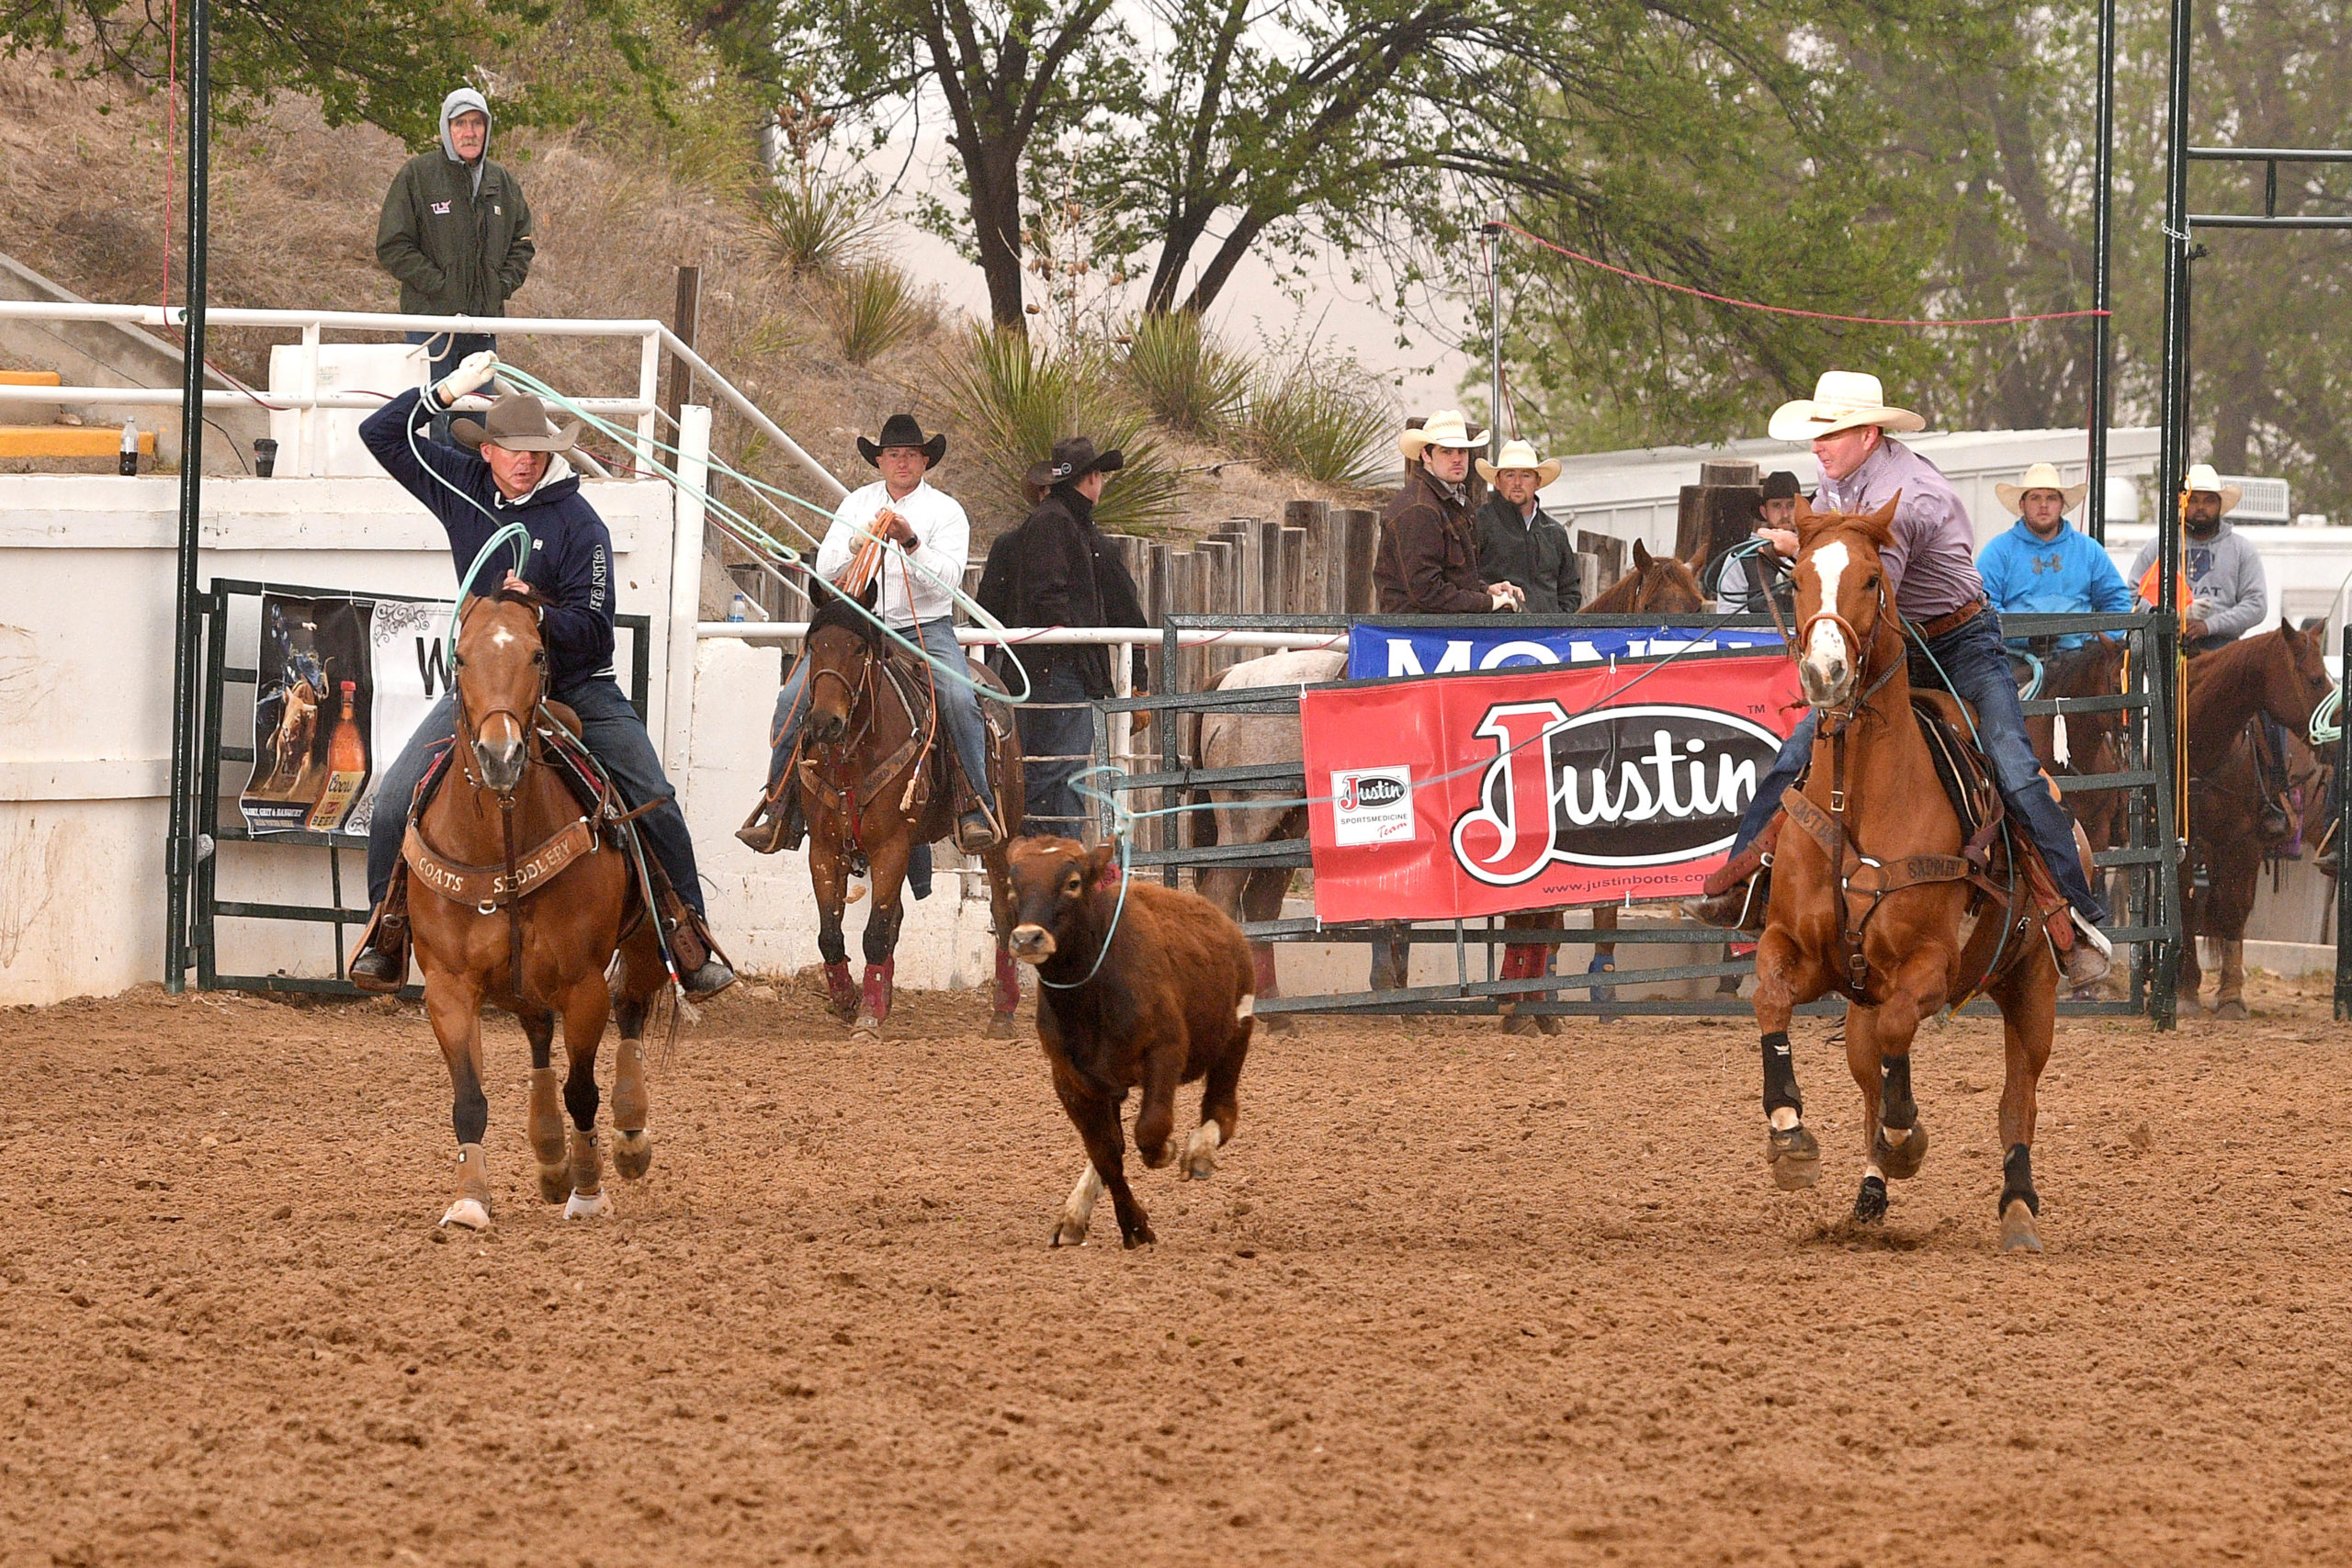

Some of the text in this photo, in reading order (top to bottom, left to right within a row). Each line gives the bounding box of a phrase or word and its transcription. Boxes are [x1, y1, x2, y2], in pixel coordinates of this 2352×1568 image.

[1747, 705, 1766, 714] TM
[1339, 776, 1401, 813] Justin
[1450, 700, 1757, 886] Justin
[1340, 814, 1408, 825] SPORTSMEDICINE
[1377, 822, 1408, 839] Team
[417, 838, 571, 895] COATS SDDLERY
